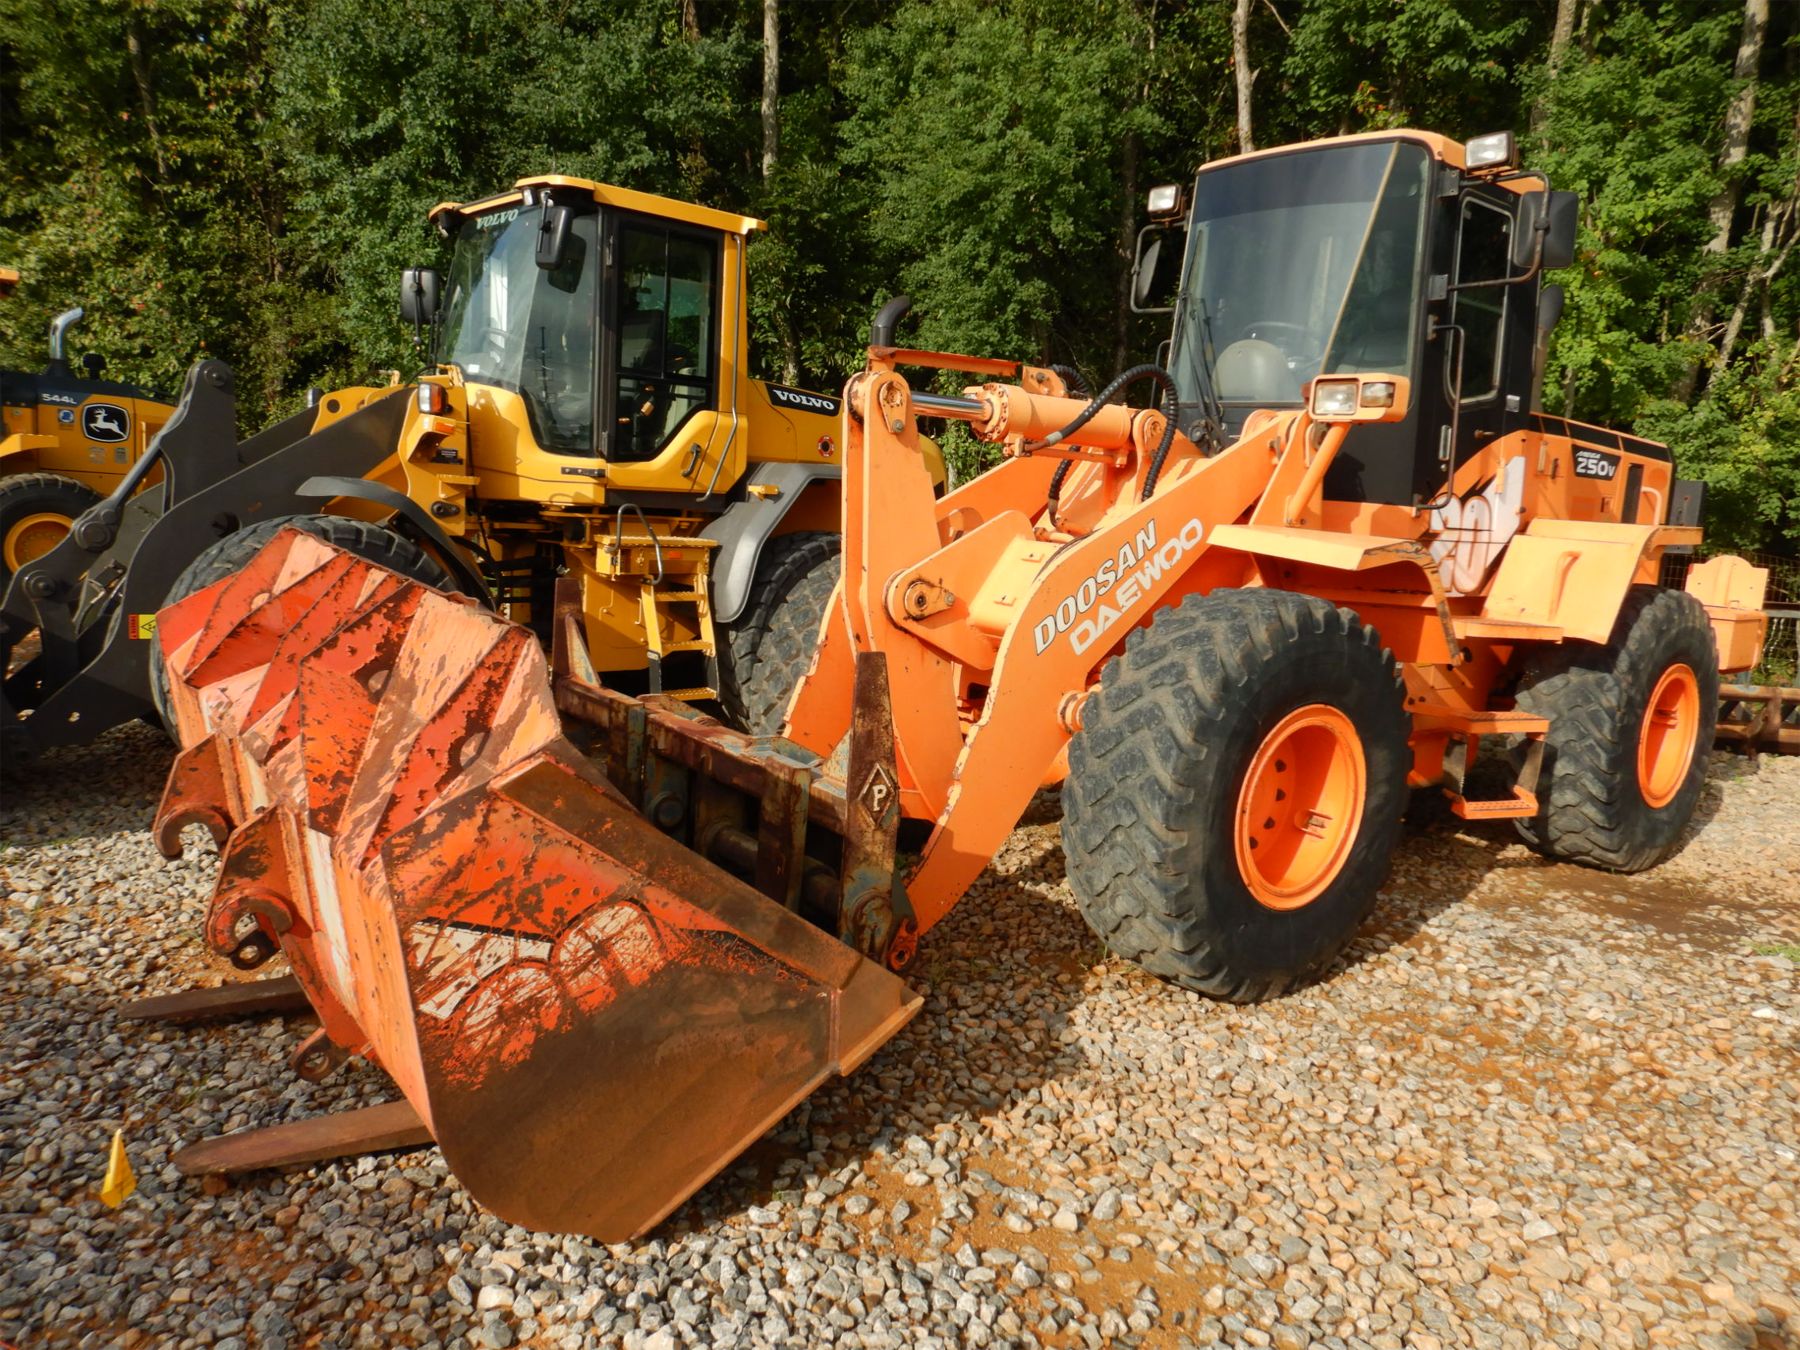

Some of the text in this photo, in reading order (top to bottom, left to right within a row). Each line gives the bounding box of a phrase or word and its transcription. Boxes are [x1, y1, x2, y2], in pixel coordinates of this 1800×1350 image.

[475, 208, 519, 230] VOLVO
[773, 389, 835, 411] VOLVO
[1033, 518, 1157, 656] DOOSAN
[1069, 517, 1204, 656] DAEWOO
[872, 784, 887, 812] P
